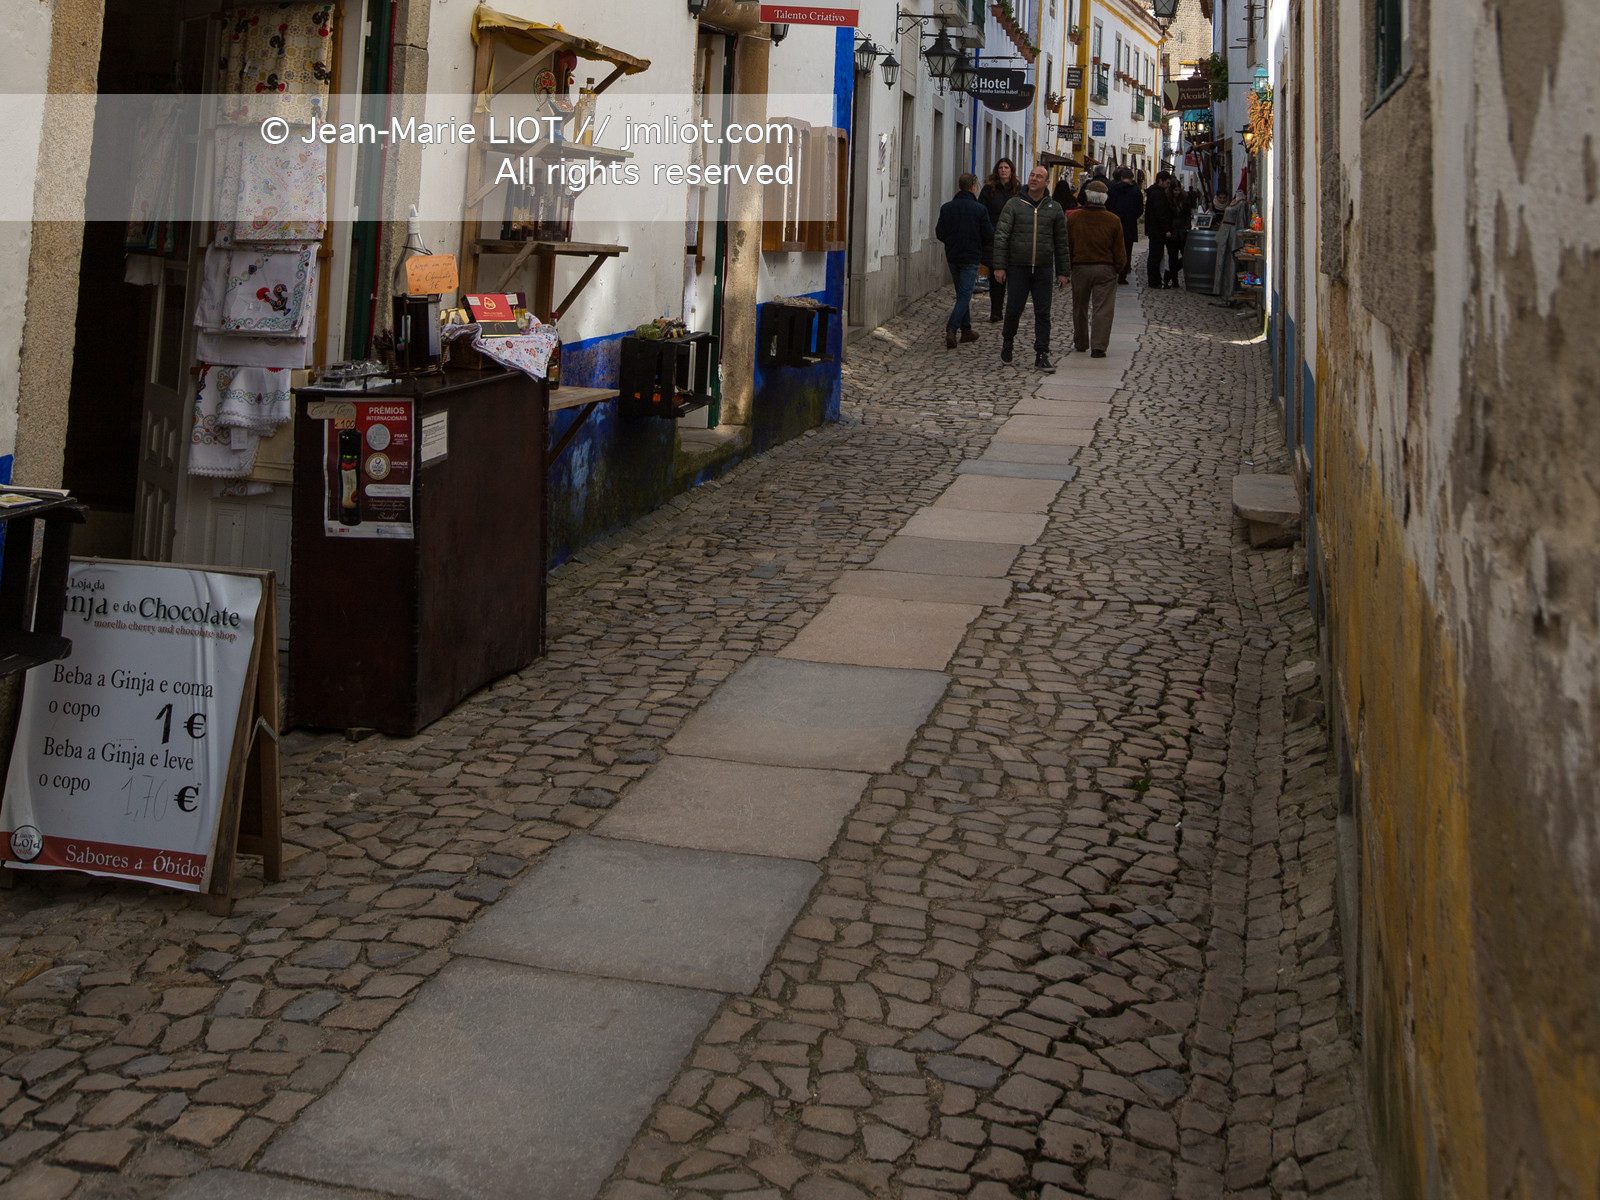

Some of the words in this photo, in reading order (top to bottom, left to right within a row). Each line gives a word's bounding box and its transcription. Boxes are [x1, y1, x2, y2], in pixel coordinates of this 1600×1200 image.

[774, 9, 808, 20] Talento
[809, 12, 846, 23] Criativo
[980, 77, 1010, 89] Hotel
[368, 406, 405, 415] PRÉMIOS
[71, 578, 92, 591] Loja
[93, 579, 106, 590] da
[64, 586, 108, 621] inja
[113, 601, 120, 611] e
[123, 600, 137, 613] do
[139, 597, 240, 628] Chocolate
[94, 620, 126, 632] morello
[128, 623, 157, 636] cherry
[157, 624, 174, 634] and
[54, 664, 93, 686] Beba
[98, 673, 106, 687] a
[111, 670, 155, 697] Ginja
[159, 681, 168, 693] e
[173, 679, 214, 698] coma
[49, 701, 57, 713] o
[63, 699, 101, 722] copo
[155, 703, 173, 745] 1
[183, 712, 208, 739] €
[43, 736, 83, 760] Beba
[87, 747, 96, 760] a
[101, 742, 146, 770] Ginja
[149, 754, 159, 767] e
[164, 749, 194, 771] leve
[39, 774, 48, 787] o
[53, 773, 91, 796] copo
[173, 785, 200, 813] €
[13, 833, 41, 851] Loja
[65, 845, 129, 869] Sabores
[134, 858, 144, 871] a
